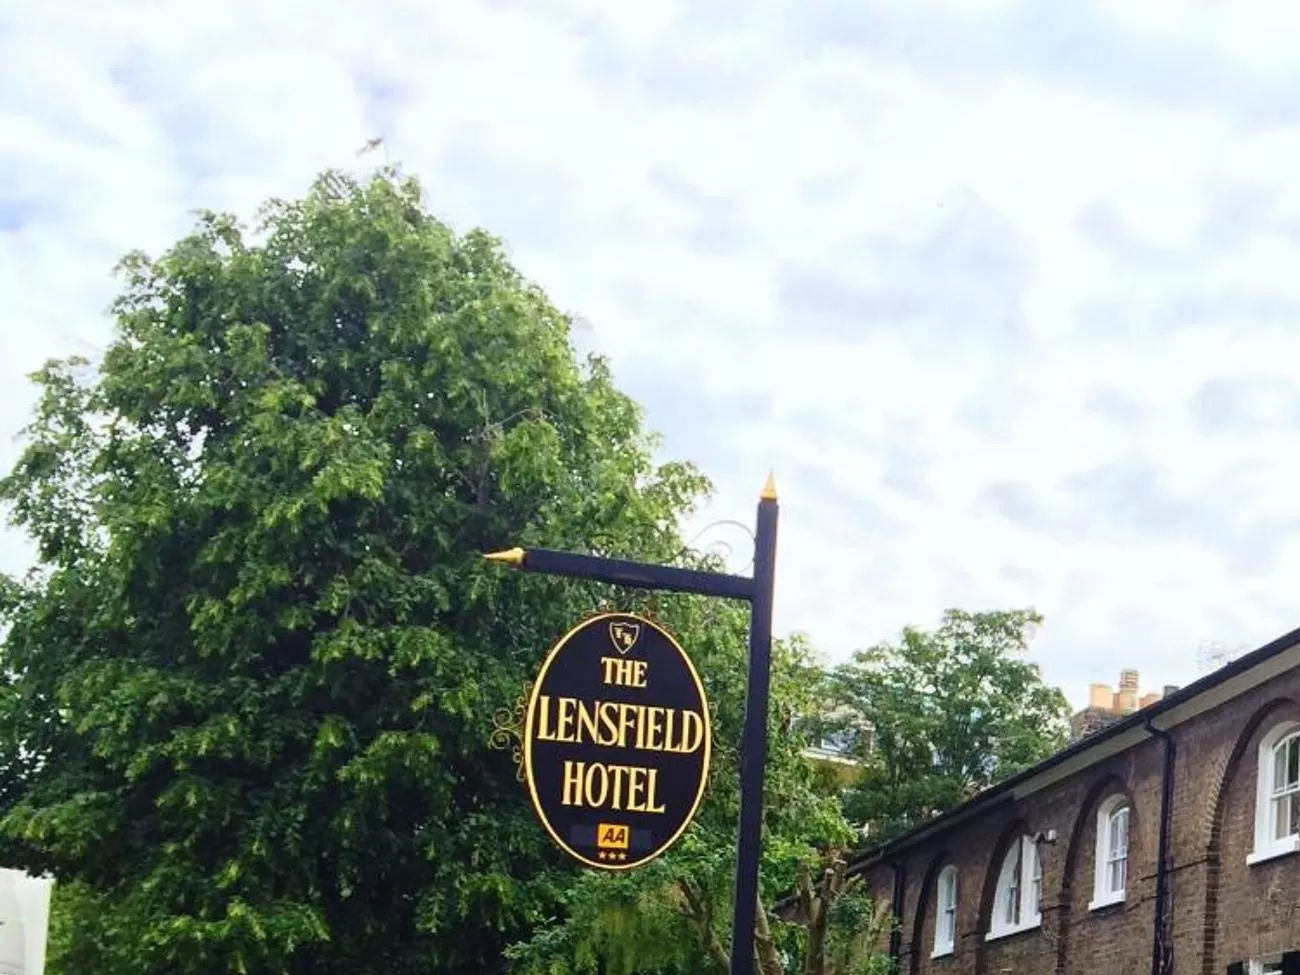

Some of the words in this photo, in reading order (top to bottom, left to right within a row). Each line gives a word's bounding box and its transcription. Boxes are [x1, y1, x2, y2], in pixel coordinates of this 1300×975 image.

[601, 657, 648, 687] THE
[537, 695, 703, 753] LENSFIELD
[562, 761, 665, 813] HOTEL
[602, 828, 625, 844] AA
